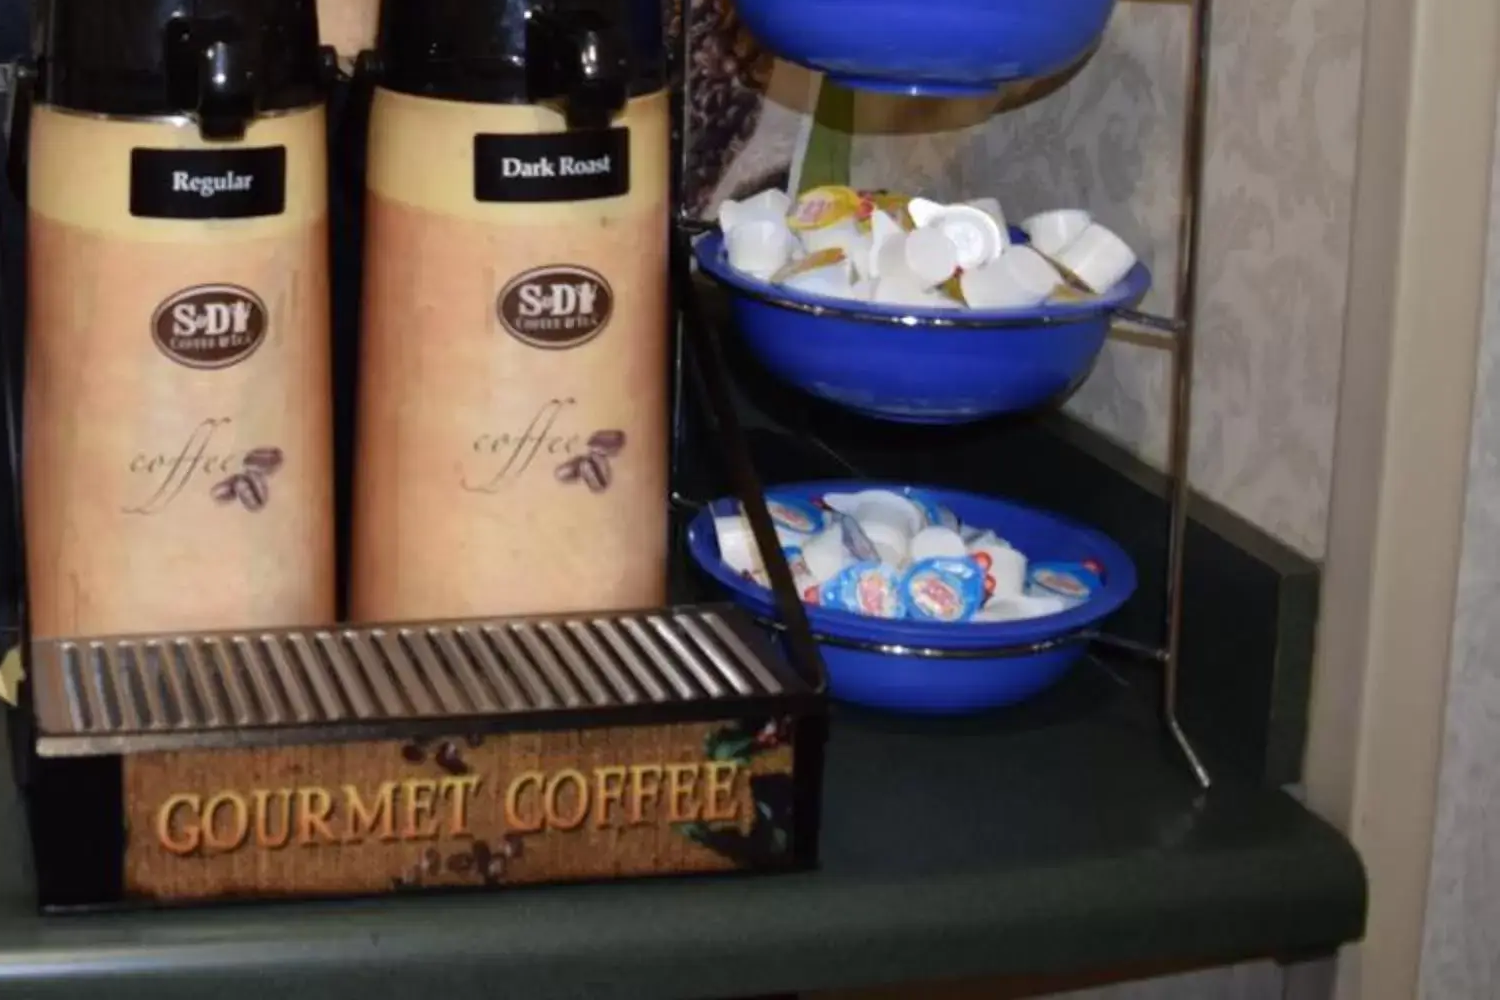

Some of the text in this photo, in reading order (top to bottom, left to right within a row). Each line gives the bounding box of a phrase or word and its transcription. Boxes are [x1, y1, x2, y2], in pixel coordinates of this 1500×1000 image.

[501, 154, 611, 178] Dark Roast
[171, 170, 254, 198] Regular
[156, 760, 742, 856] GOURMET COFFEE
